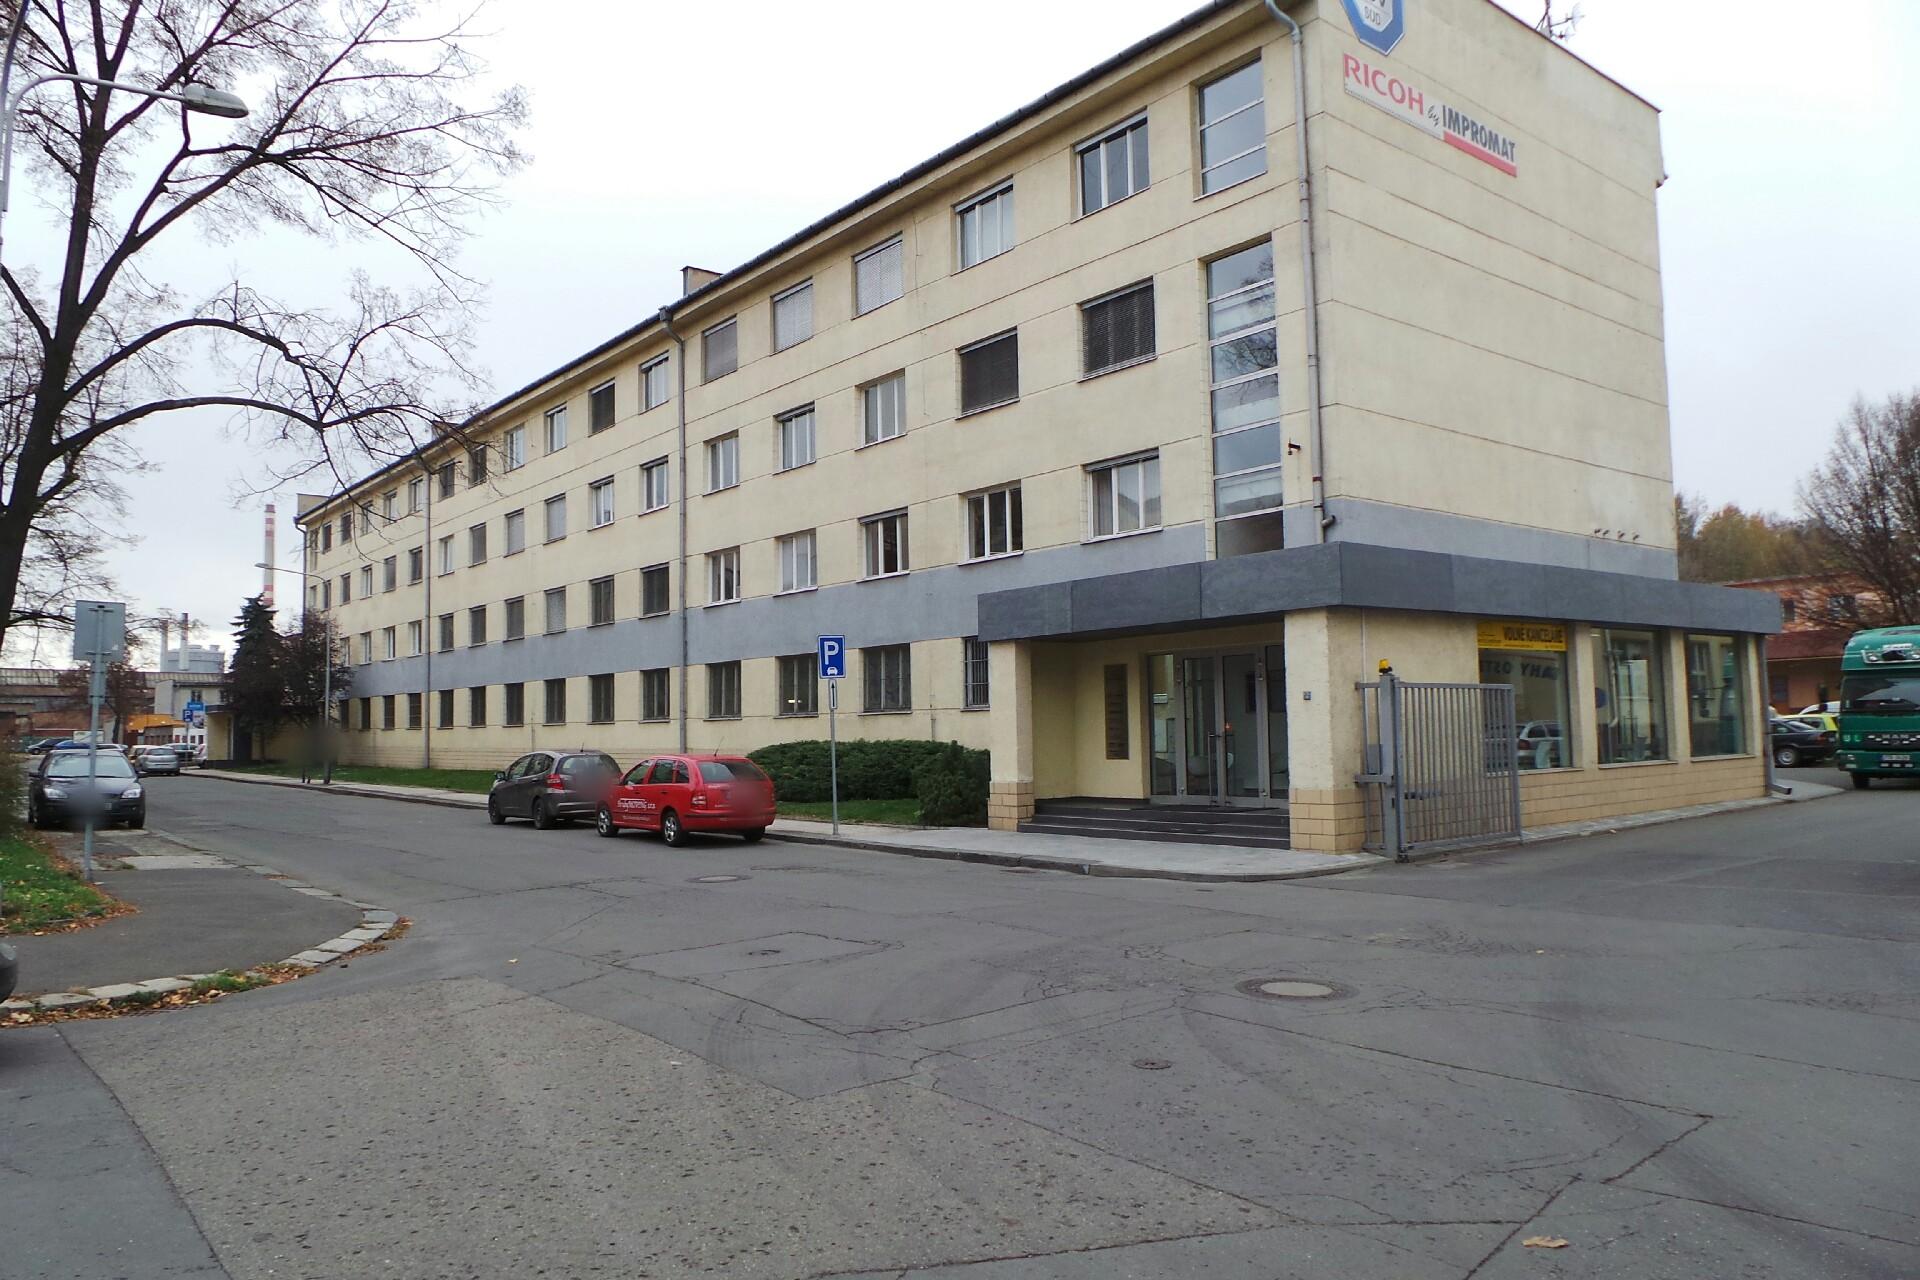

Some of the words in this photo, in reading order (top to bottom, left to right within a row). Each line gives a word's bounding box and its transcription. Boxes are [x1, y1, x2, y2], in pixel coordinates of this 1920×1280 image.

[1343, 53, 1424, 115] RICOH
[1442, 104, 1515, 162] IMPROMAT
[824, 641, 839, 665] P
